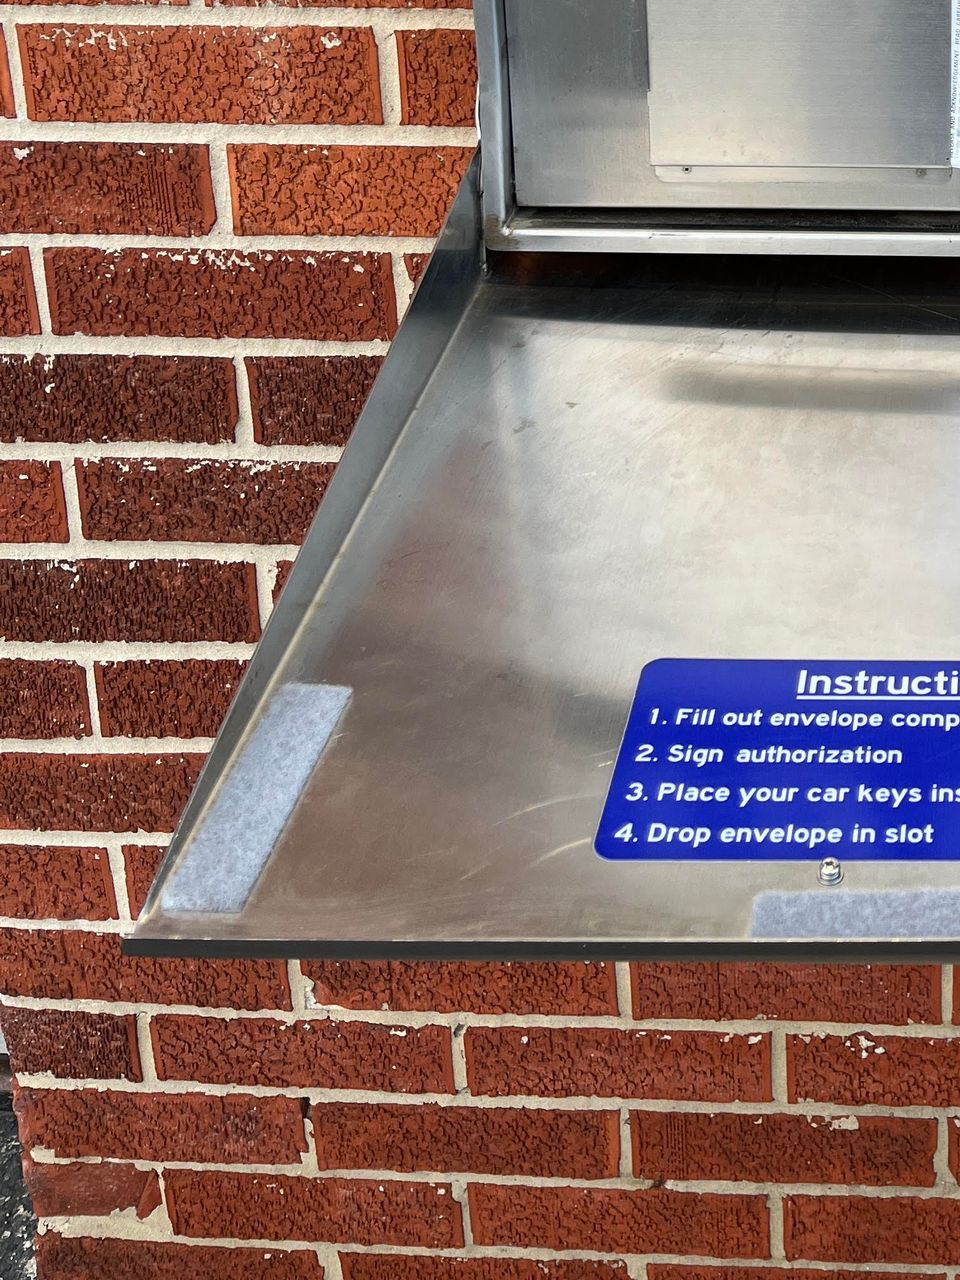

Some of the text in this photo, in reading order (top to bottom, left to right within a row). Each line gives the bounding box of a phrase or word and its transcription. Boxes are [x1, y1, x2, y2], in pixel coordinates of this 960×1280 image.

[650, 708, 667, 725] 1.
[675, 708, 715, 726] Fill
[722, 709, 763, 727] out
[769, 710, 883, 731] envelope
[634, 744, 903, 767] 2. Sign authorization
[625, 782, 649, 802] 3.
[657, 782, 730, 802] Place
[738, 786, 799, 808] your
[807, 786, 849, 802] car
[857, 784, 922, 808] keys
[614, 823, 935, 849] 4. Drop envelope in slot
